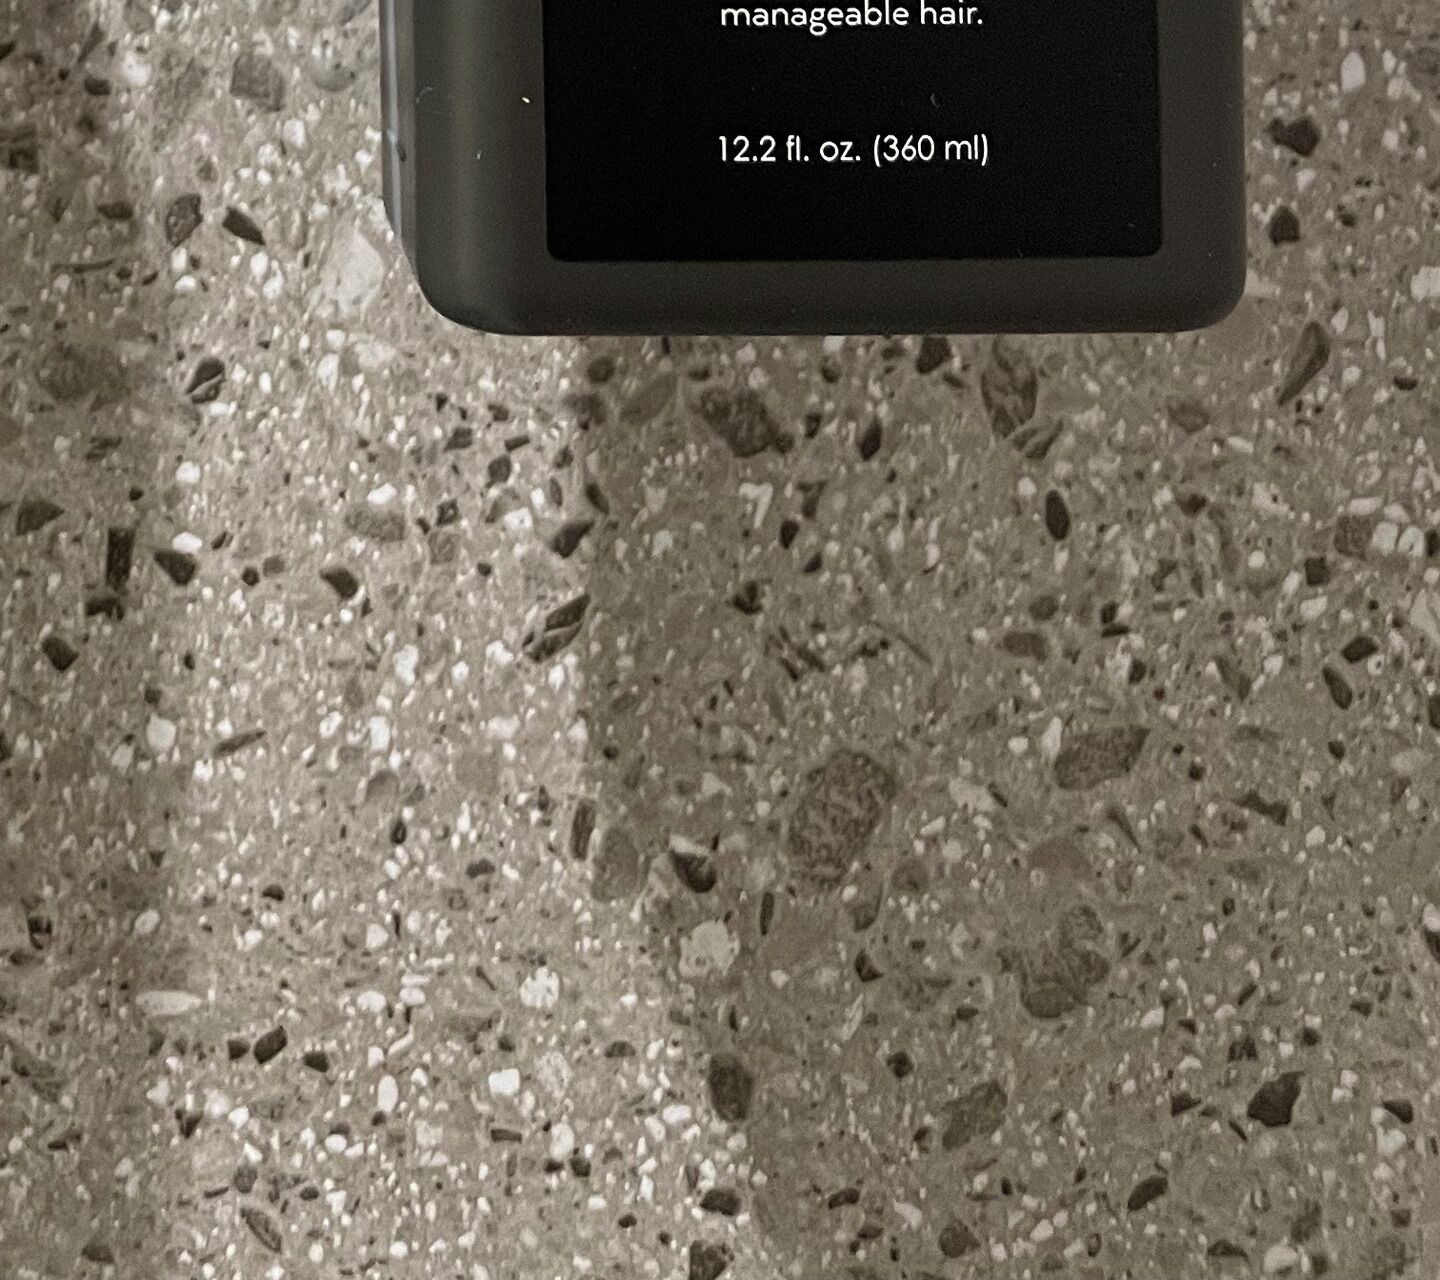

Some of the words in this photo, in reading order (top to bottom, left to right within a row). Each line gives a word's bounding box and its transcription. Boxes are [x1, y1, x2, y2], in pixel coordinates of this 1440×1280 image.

[718, 134, 777, 163] 12.2
[785, 134, 810, 162] fl.
[819, 140, 861, 163] oz.
[873, 134, 935, 168] (360
[944, 133, 989, 167] ml)
